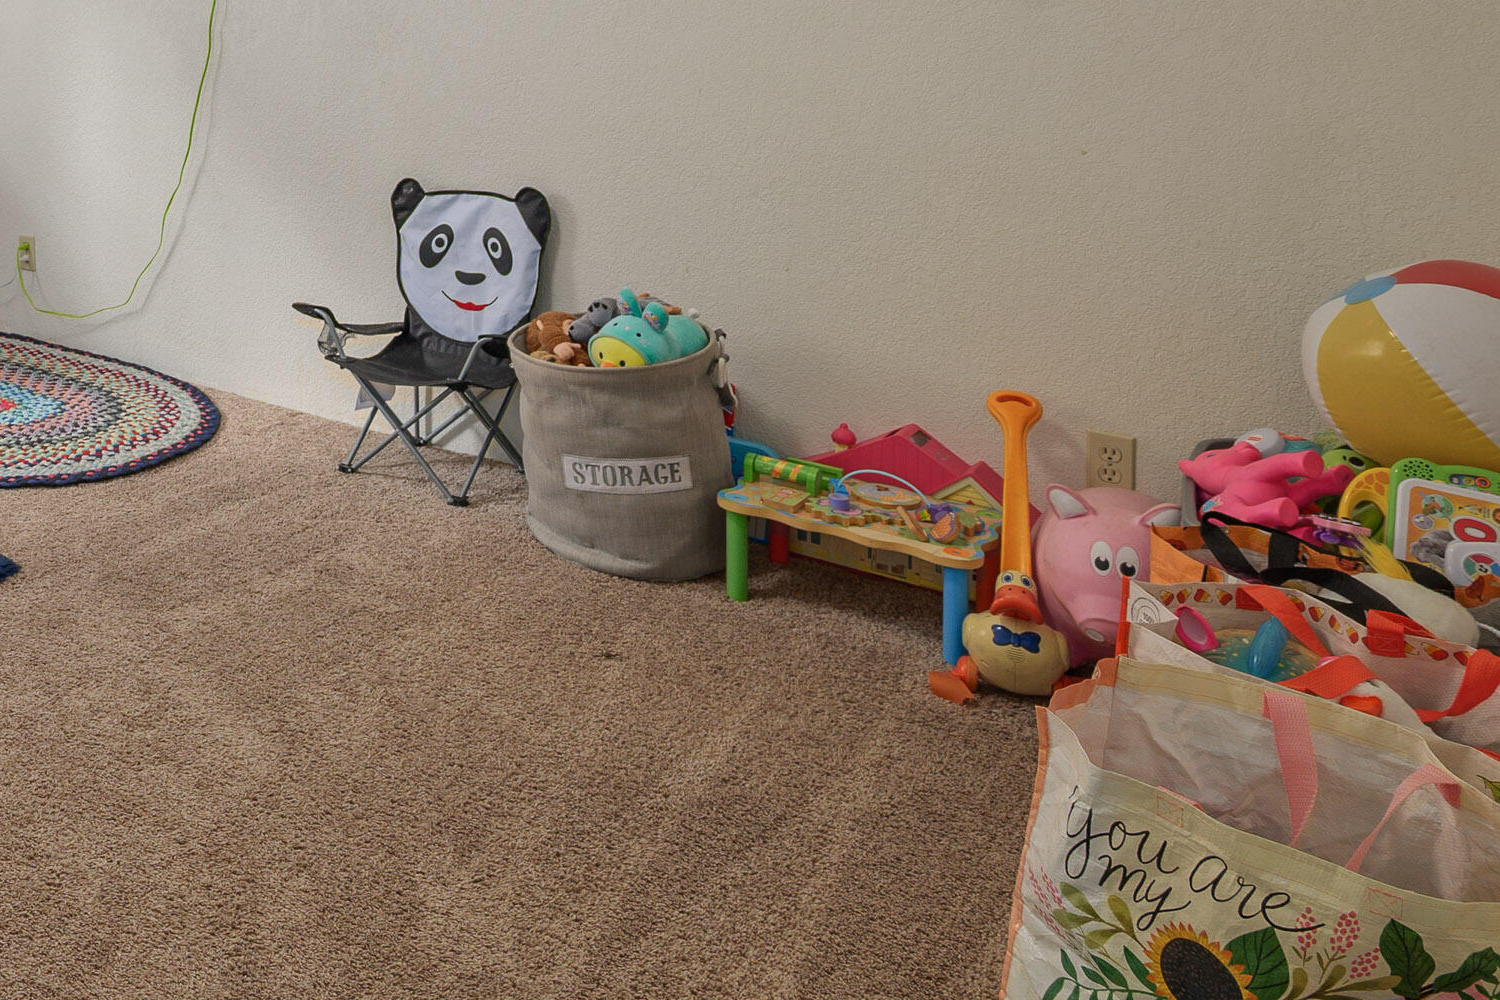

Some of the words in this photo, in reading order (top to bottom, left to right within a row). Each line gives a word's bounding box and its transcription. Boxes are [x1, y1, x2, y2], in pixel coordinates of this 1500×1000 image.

[572, 461, 682, 487] STORAGE
[1099, 854, 1191, 932] my
[1188, 855, 1325, 933] are
